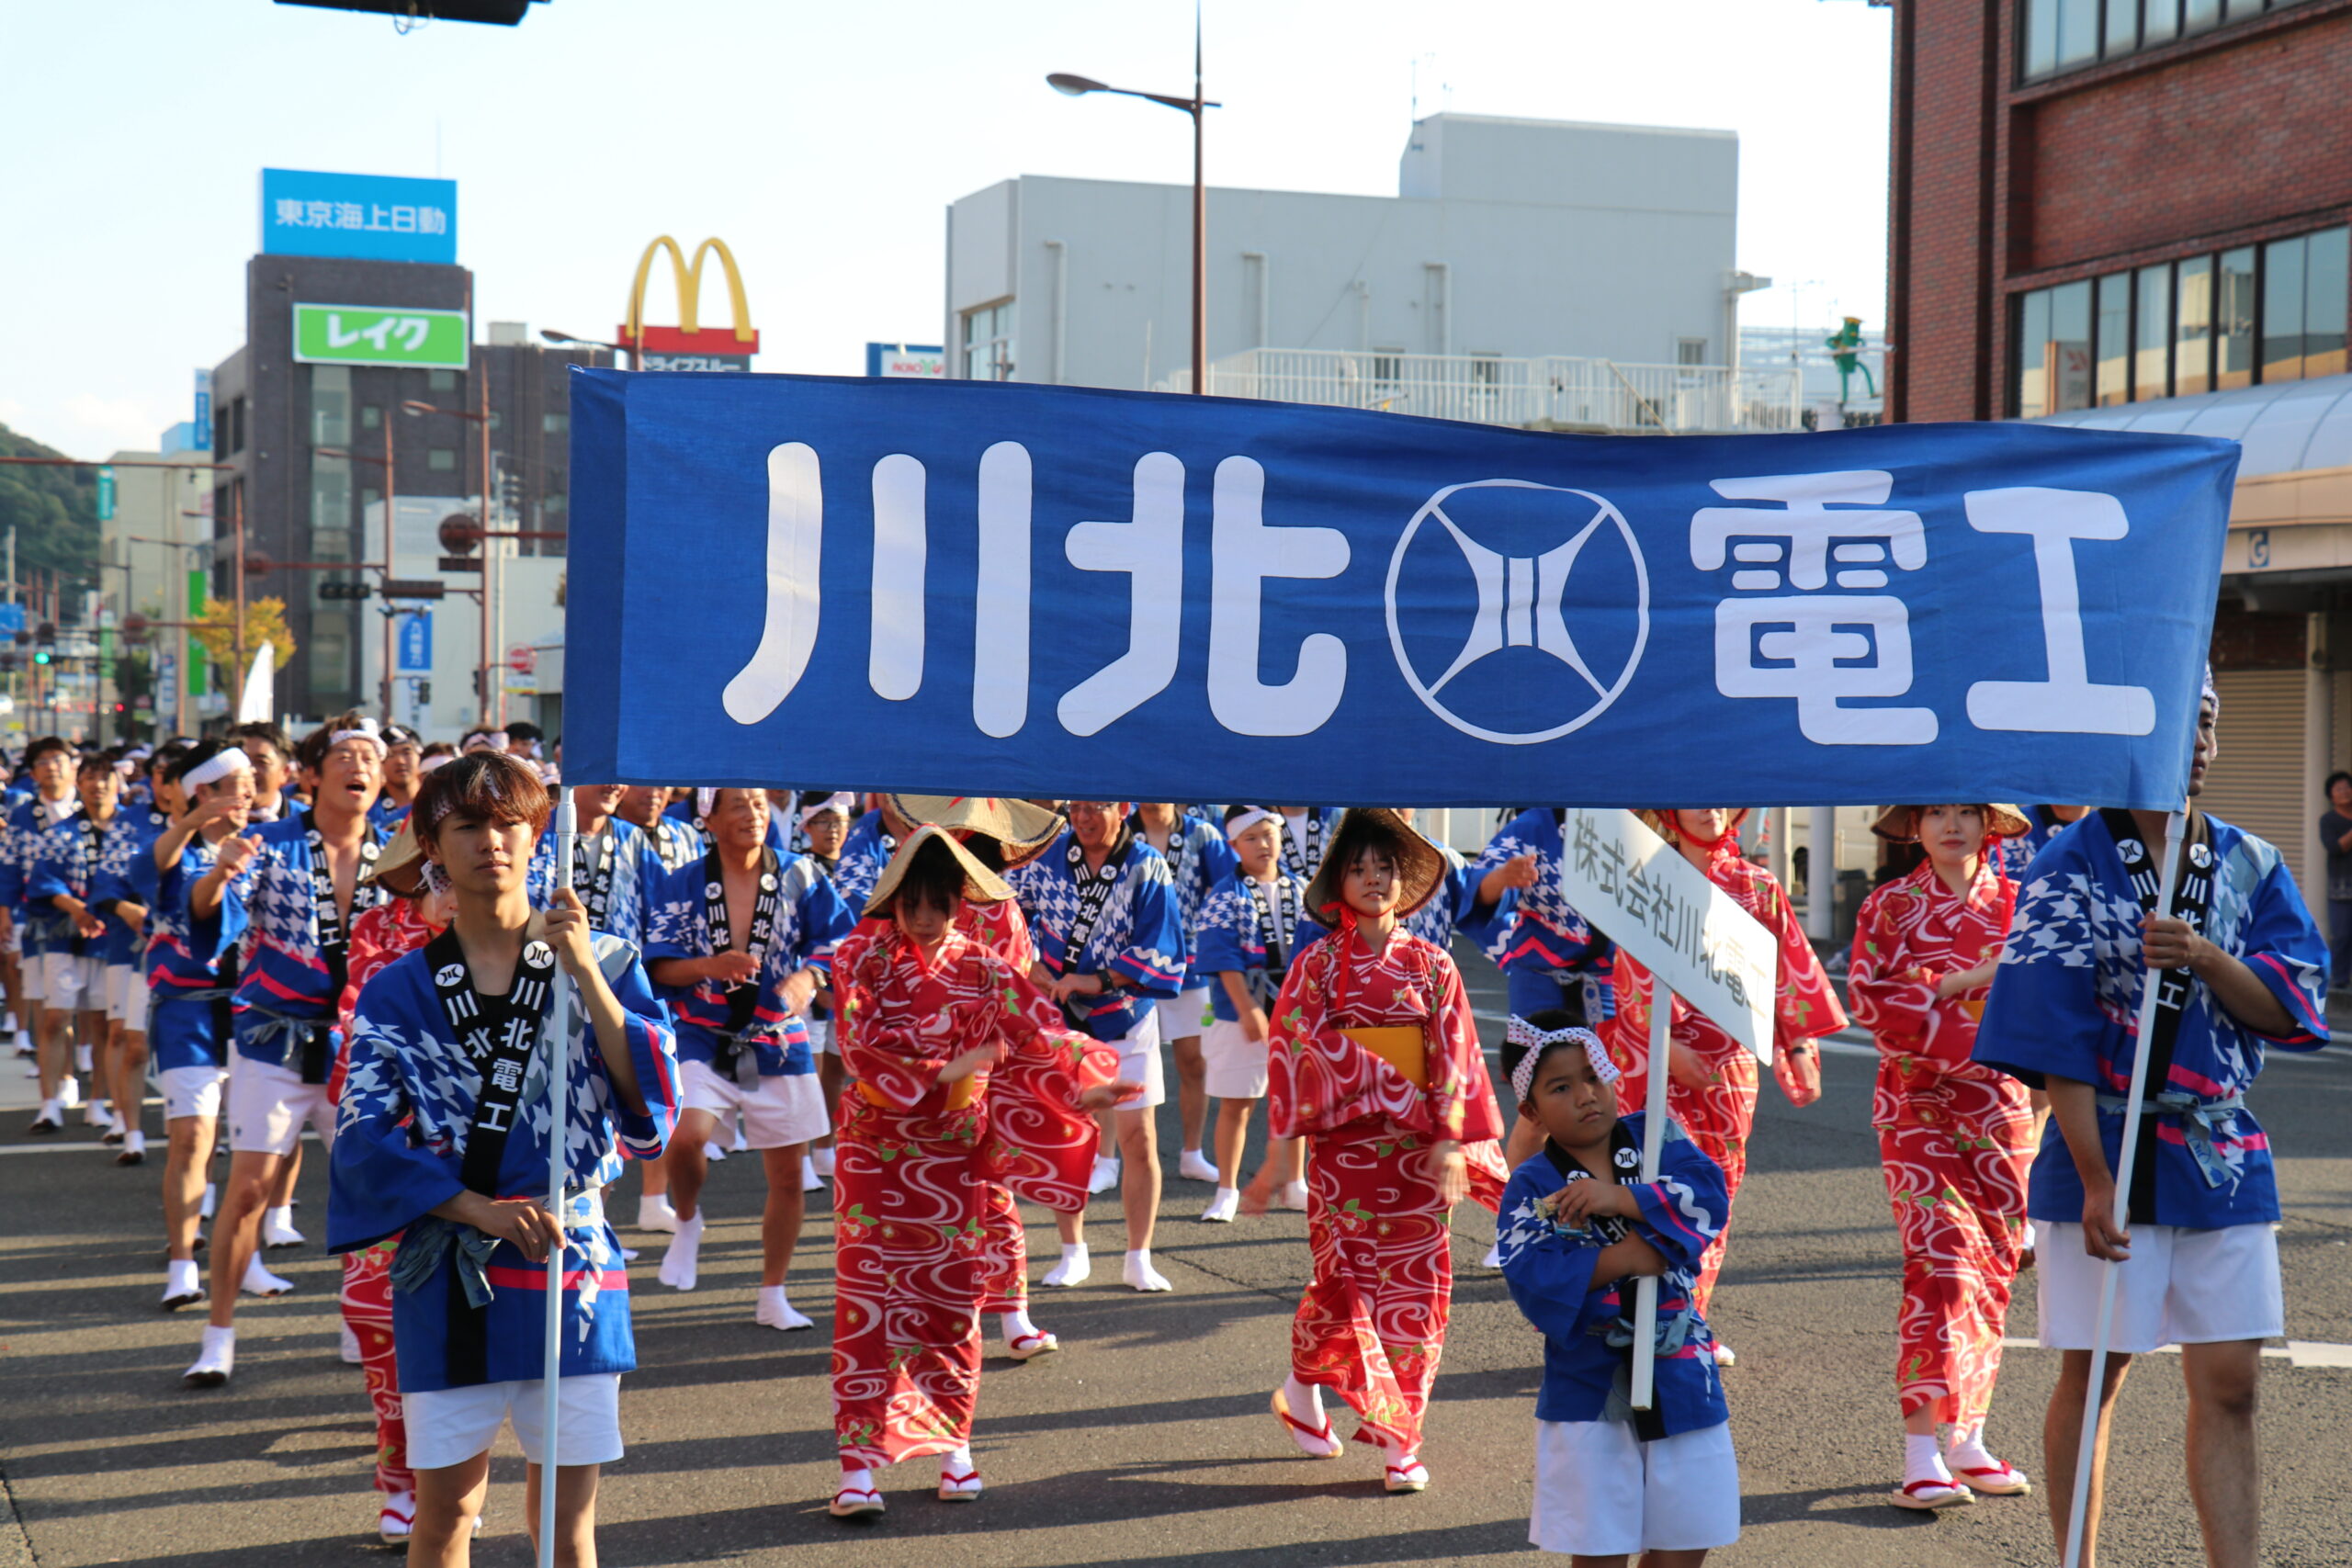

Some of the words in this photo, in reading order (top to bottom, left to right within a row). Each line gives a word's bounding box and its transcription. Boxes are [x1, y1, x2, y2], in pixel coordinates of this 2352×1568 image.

[276, 198, 447, 235] 東京海上日動
[327, 313, 430, 351] レイク
[722, 441, 1349, 738] 川北
[1689, 468, 2156, 747] 電工
[1065, 882, 1109, 964] 川北電工
[477, 976, 546, 1132] 川北電工
